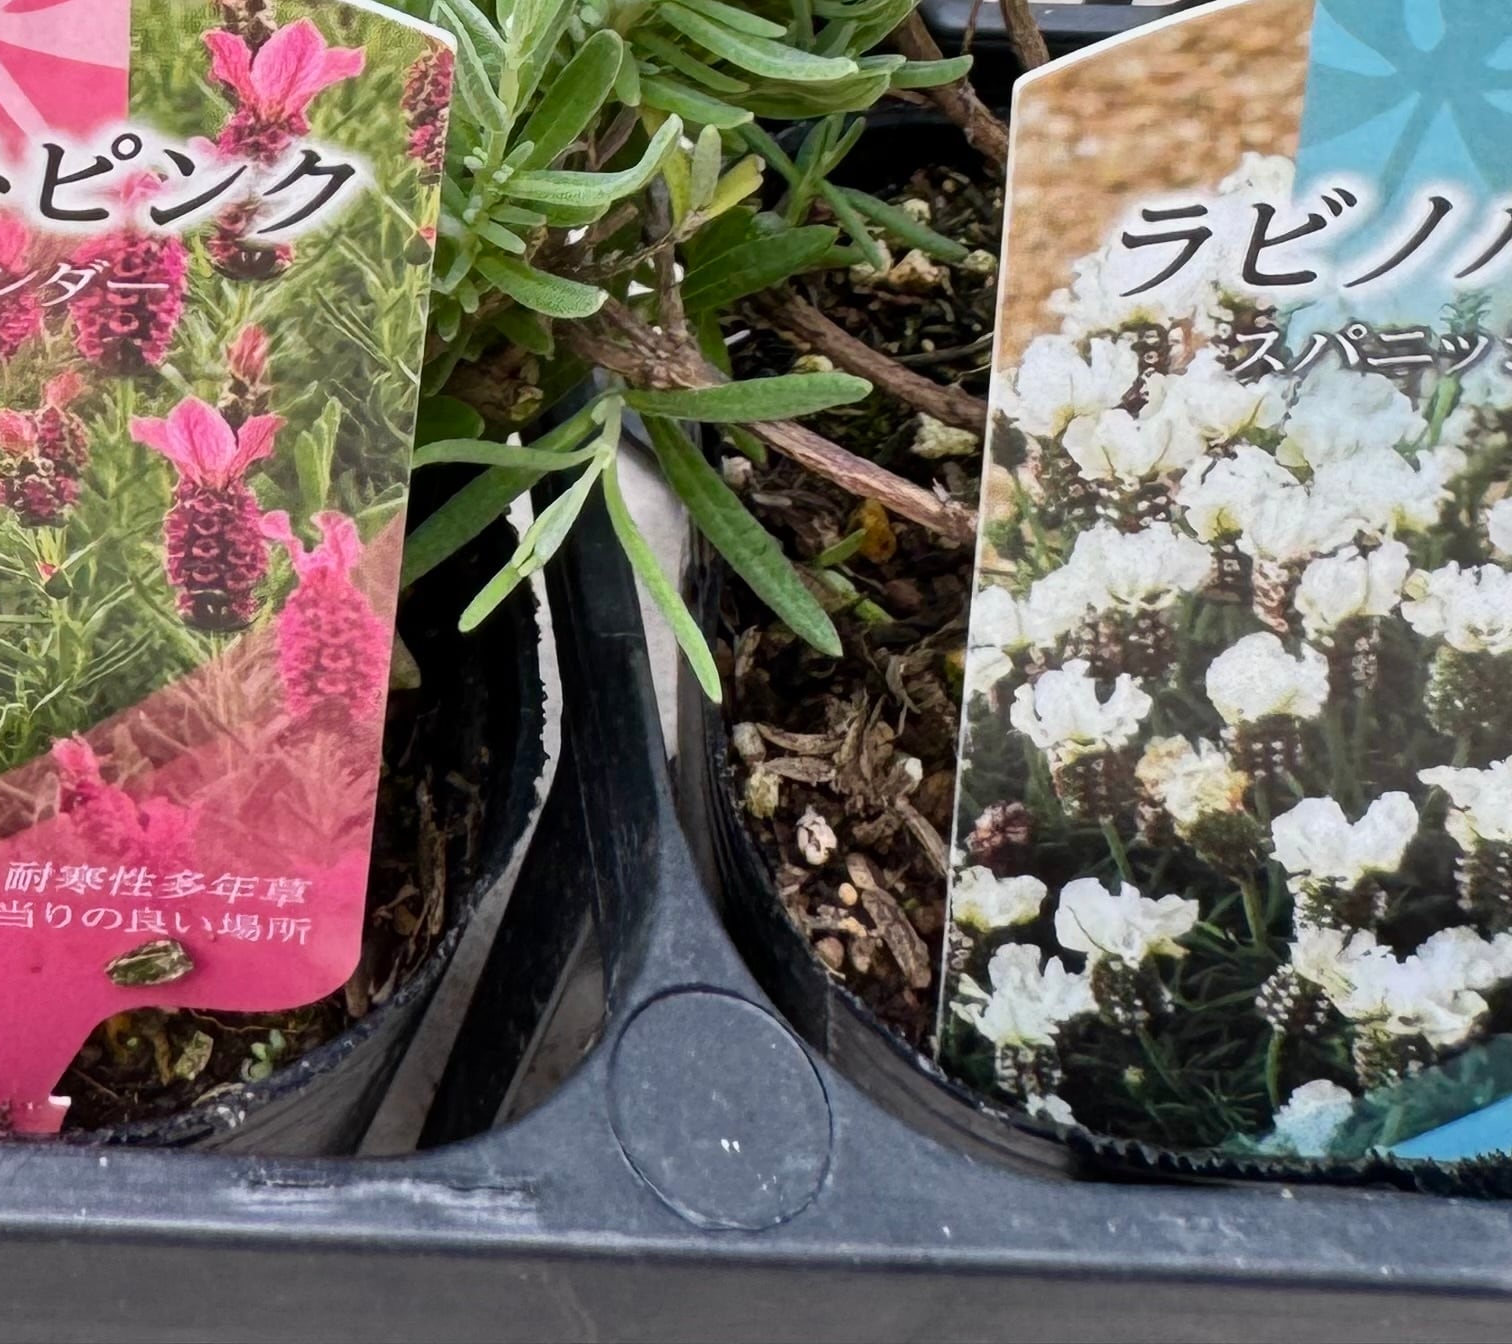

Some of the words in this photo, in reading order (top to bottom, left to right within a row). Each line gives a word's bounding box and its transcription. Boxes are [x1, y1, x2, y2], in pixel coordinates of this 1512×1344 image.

[1232, 322, 1512, 378] スパニッ
[4, 861, 313, 908] 耐寒性多年草
